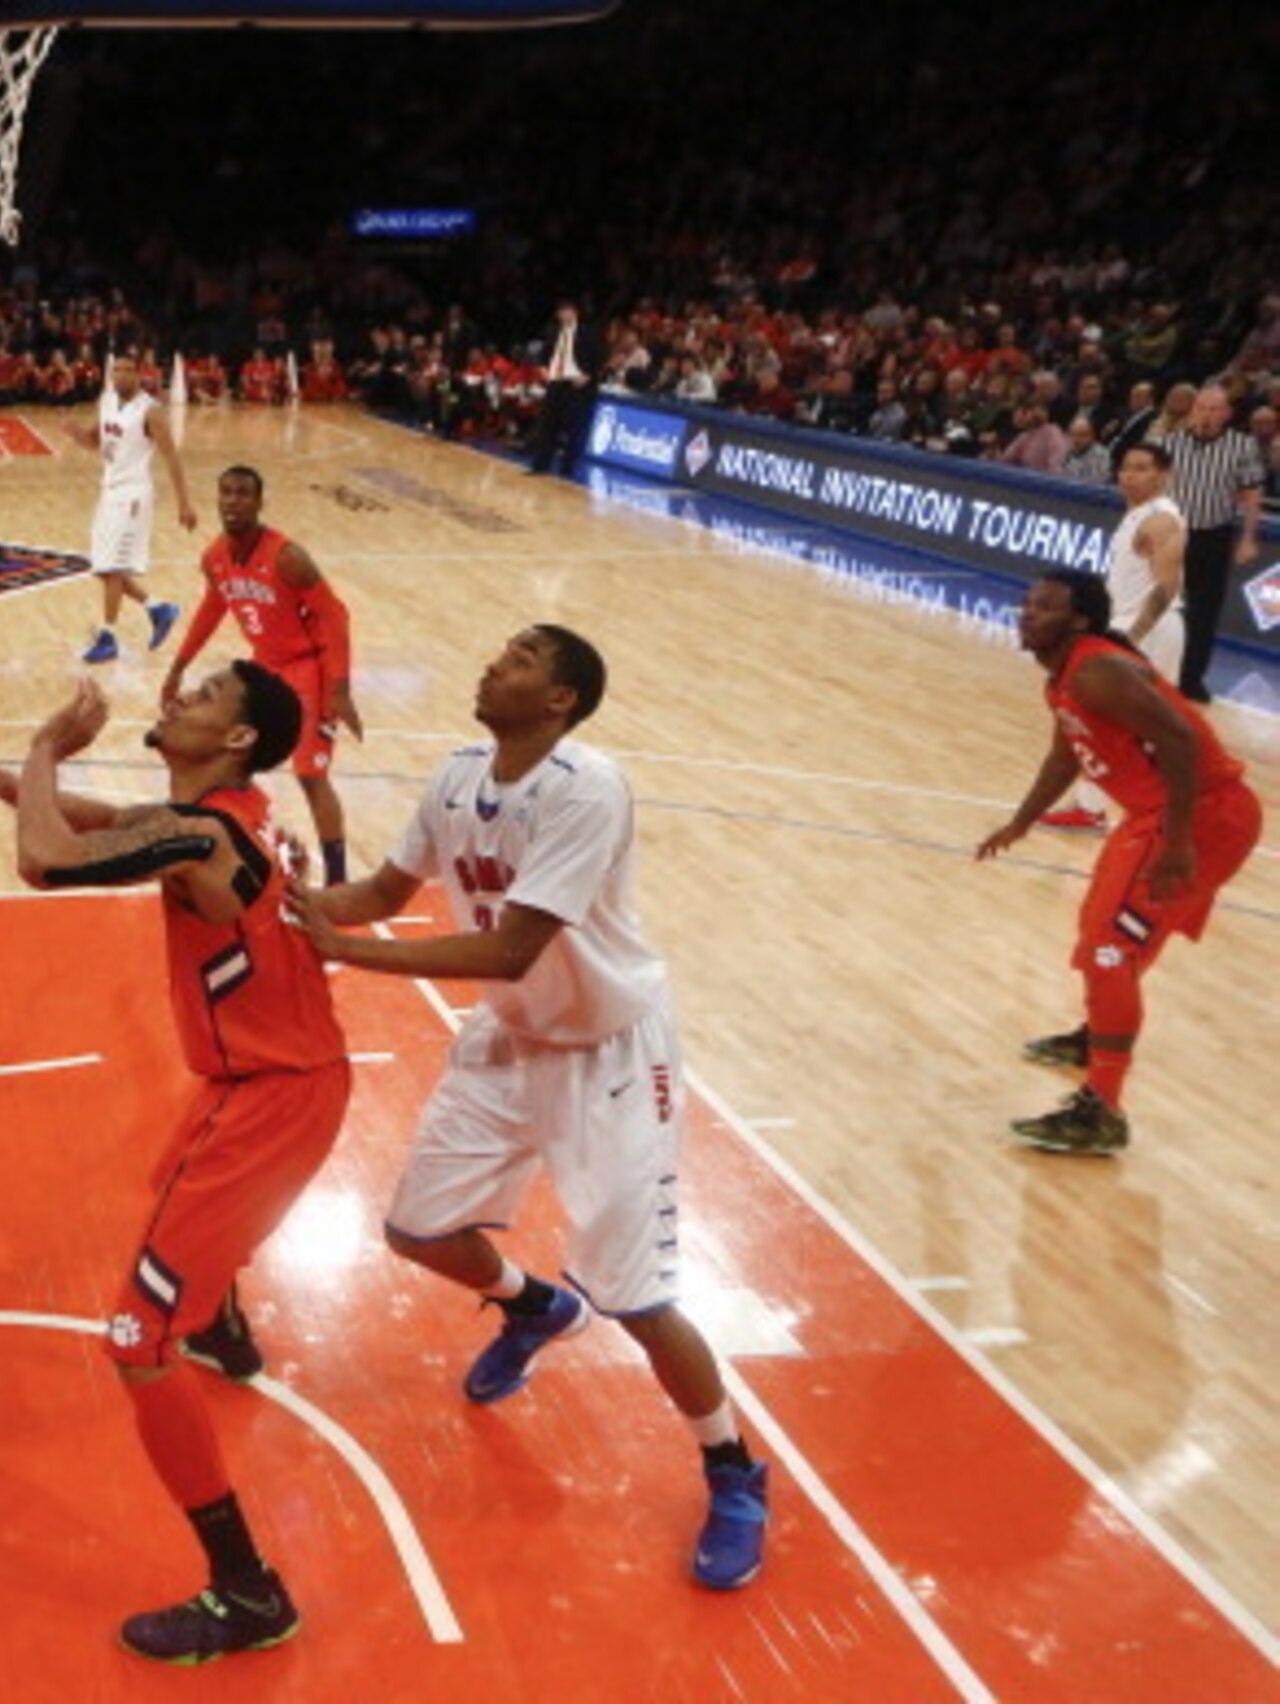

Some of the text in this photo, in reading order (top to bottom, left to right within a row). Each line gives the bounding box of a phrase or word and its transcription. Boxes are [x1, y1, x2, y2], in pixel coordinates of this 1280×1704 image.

[716, 443, 816, 500] NATIONAL
[821, 467, 963, 536] INVITATION
[969, 500, 1112, 574] TOURNA
